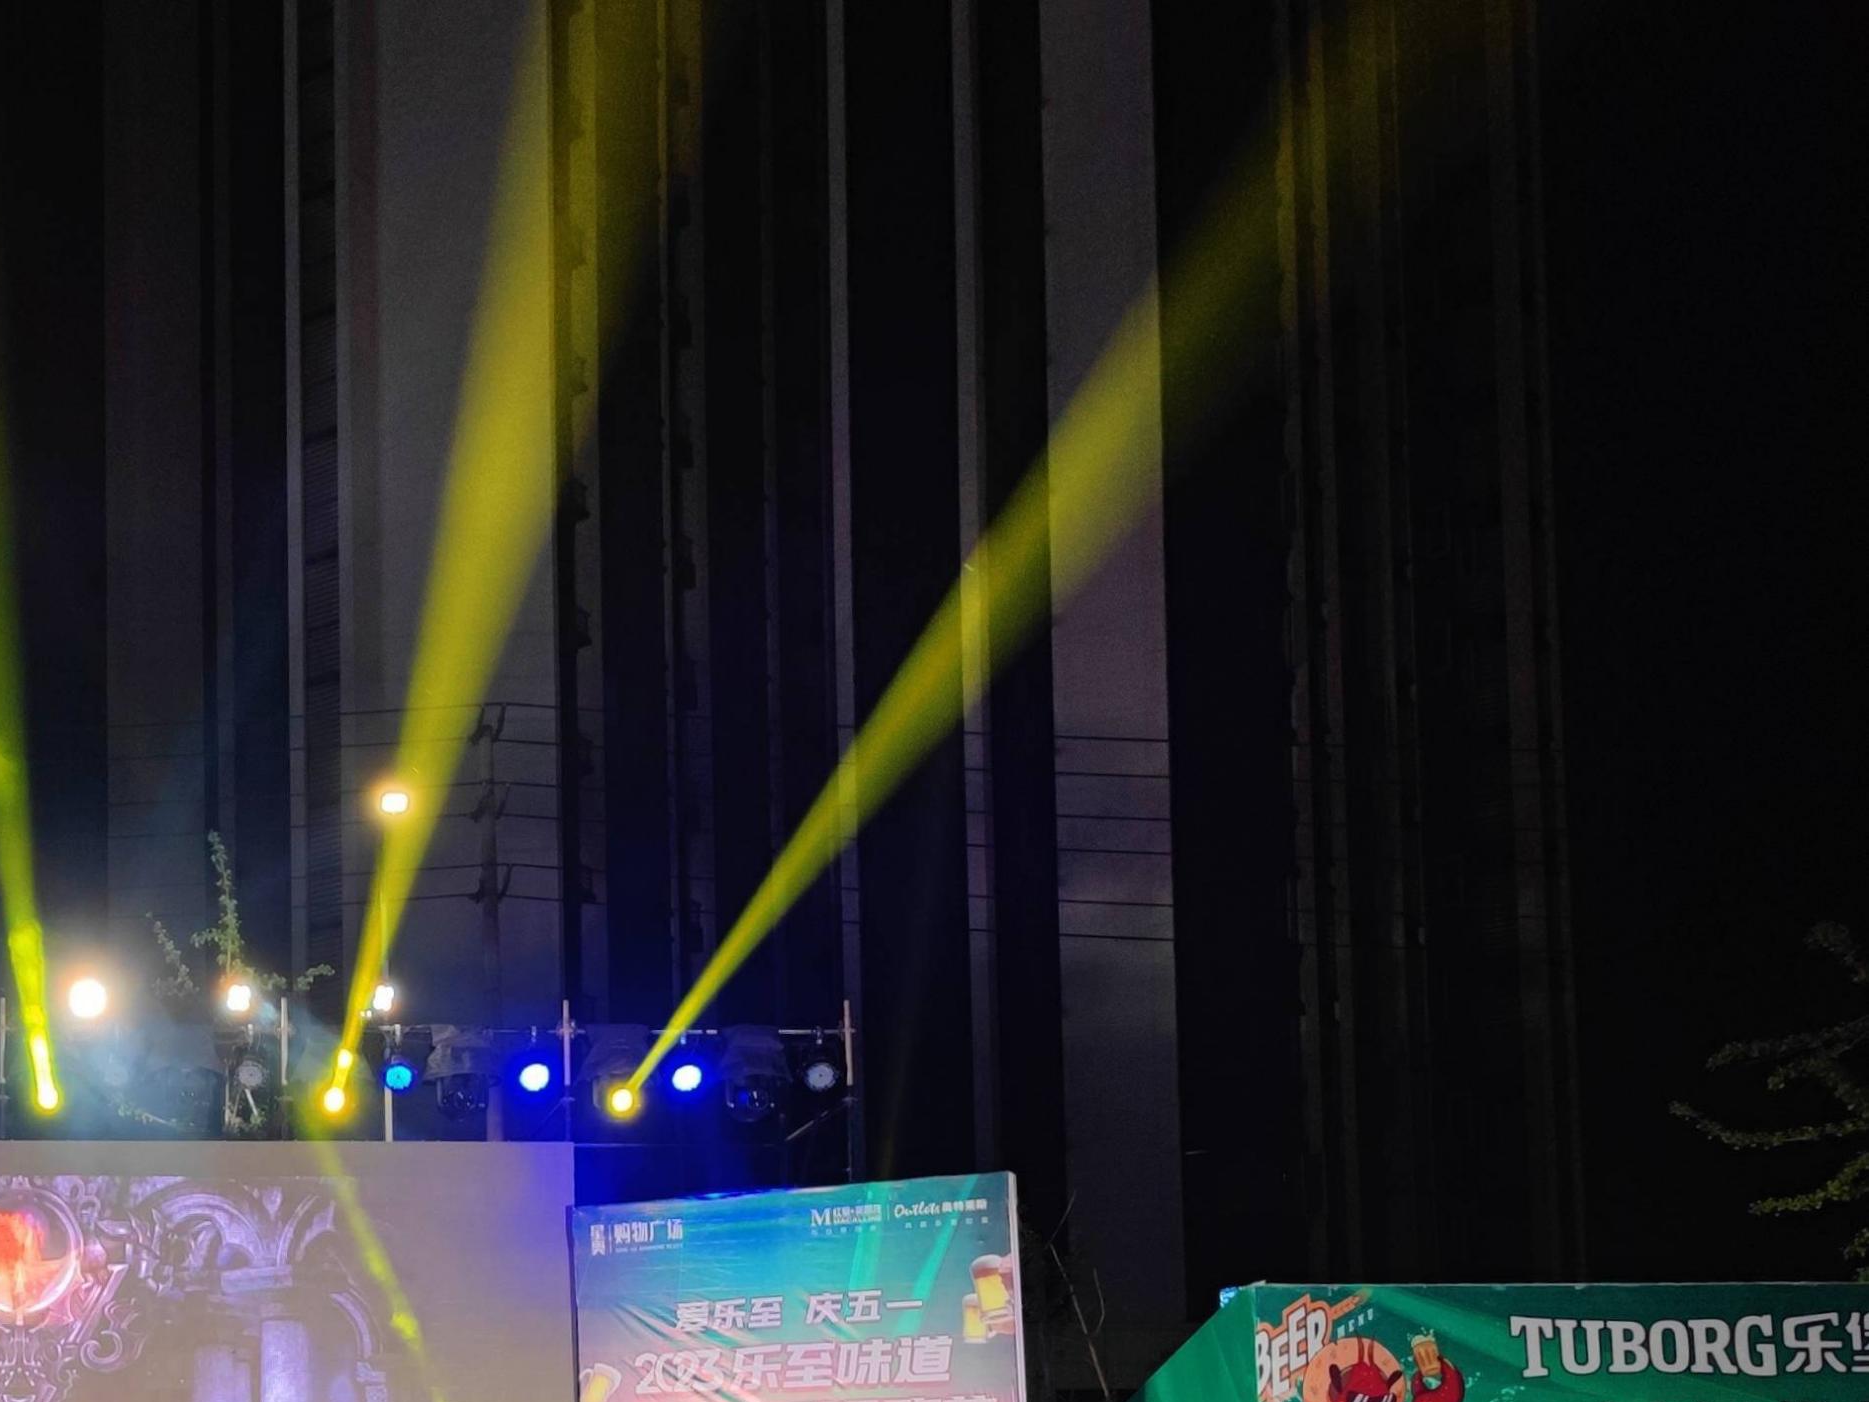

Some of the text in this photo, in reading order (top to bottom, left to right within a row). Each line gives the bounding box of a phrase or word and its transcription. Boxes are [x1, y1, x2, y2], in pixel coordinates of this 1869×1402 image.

[894, 1201, 940, 1218] Outlets
[613, 1219, 683, 1244] 购物广场
[675, 1290, 923, 1333] 爱乐至 庆五一
